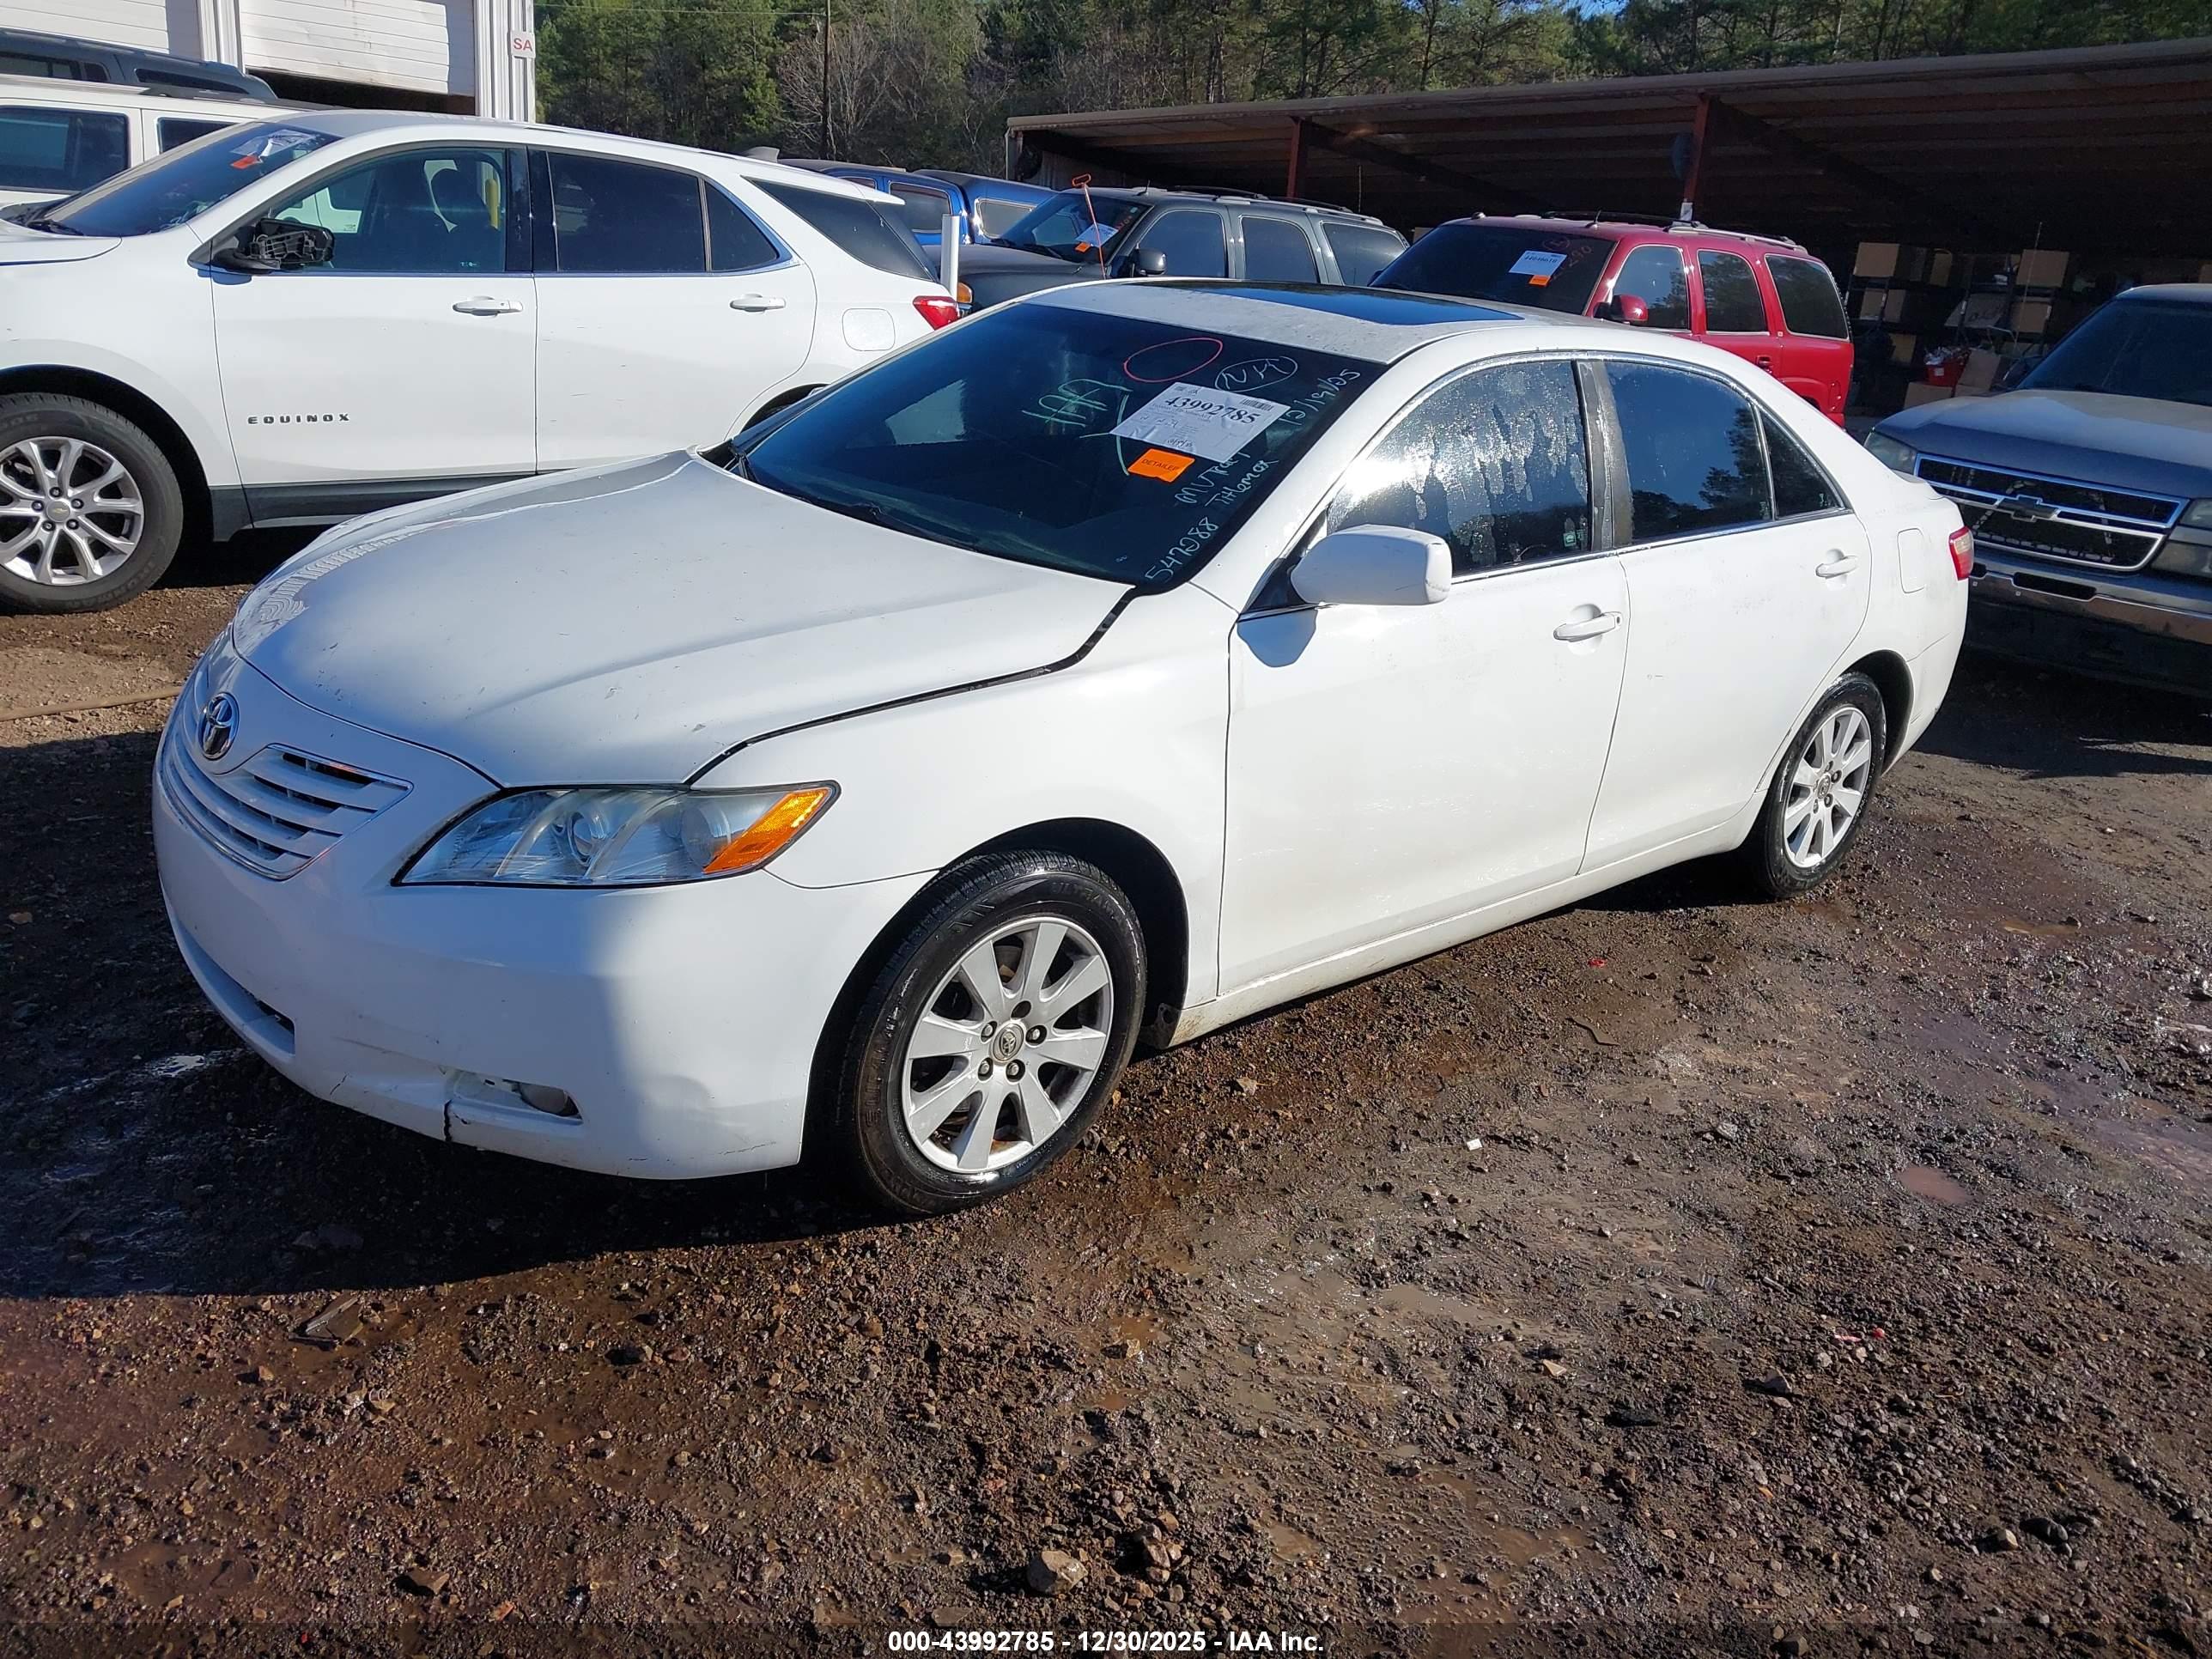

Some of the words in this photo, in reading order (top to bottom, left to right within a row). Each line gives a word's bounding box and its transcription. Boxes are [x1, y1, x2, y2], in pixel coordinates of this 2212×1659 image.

[514, 38, 533, 52] SA
[1164, 396, 1261, 424] 43992785
[246, 414, 349, 424] EQUINOX
